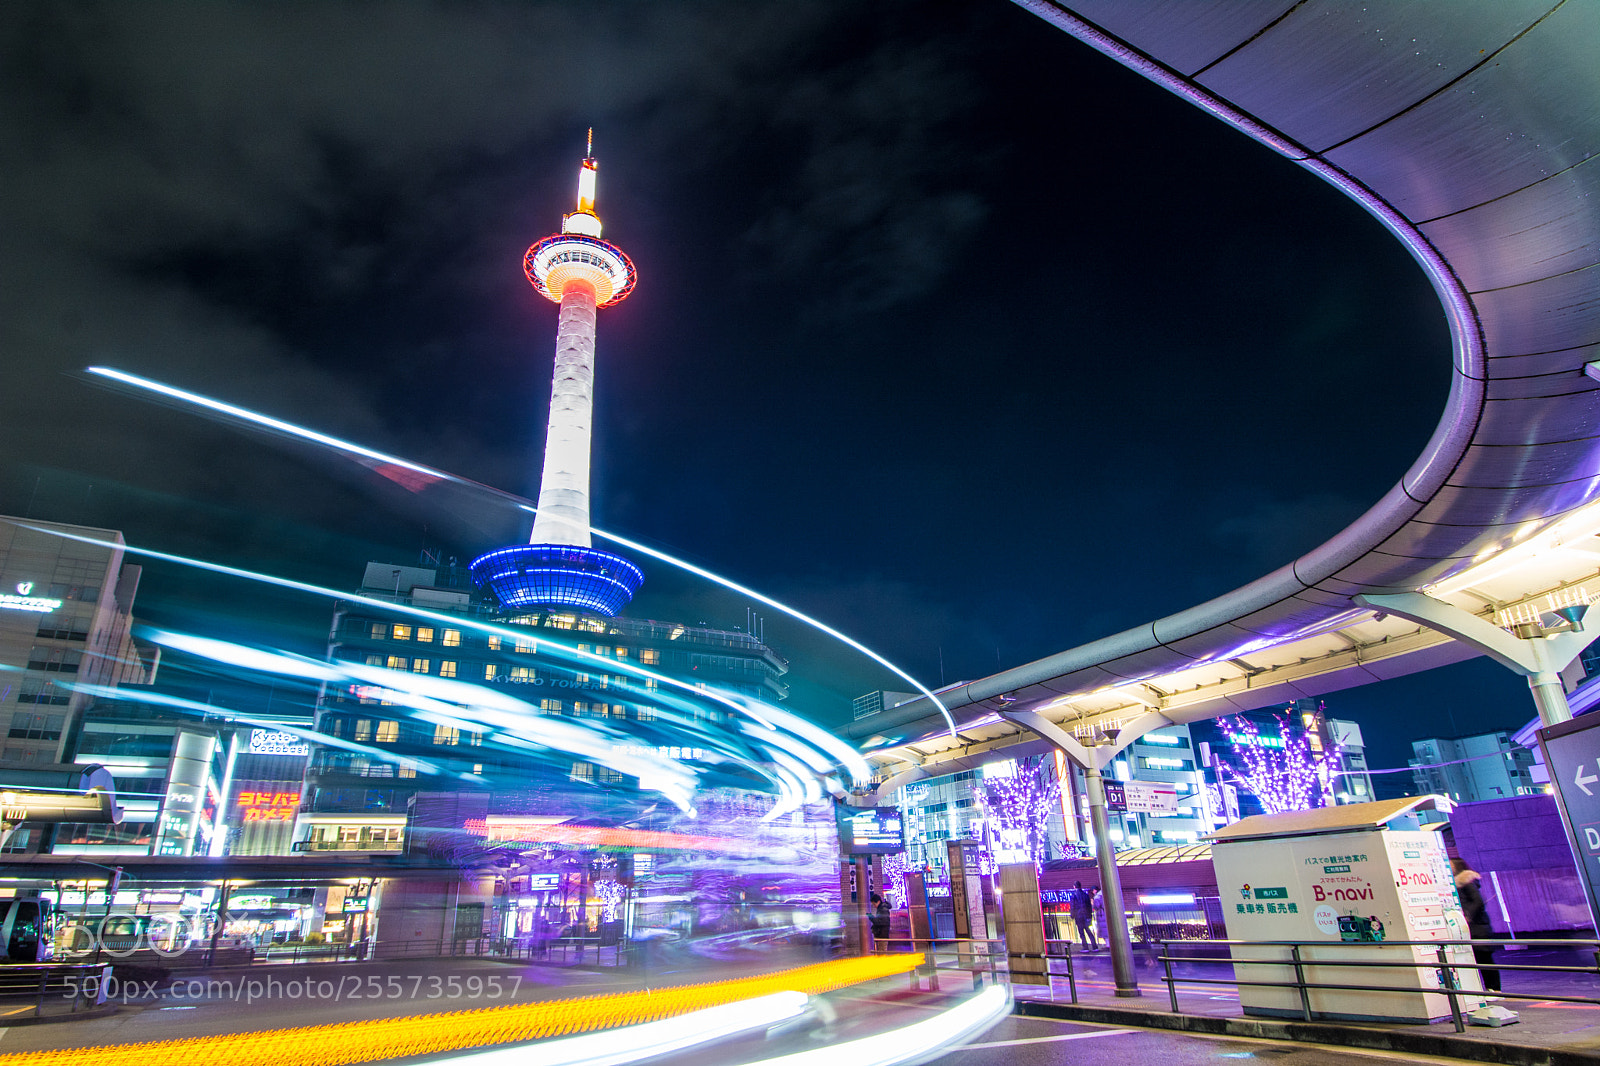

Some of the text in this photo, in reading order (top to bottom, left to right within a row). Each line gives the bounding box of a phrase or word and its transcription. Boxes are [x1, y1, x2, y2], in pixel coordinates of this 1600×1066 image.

[1110, 793, 1122, 803] D1
[244, 808, 293, 821] カメラ
[965, 854, 977, 863] D1
[1312, 882, 1374, 902] B-navi
